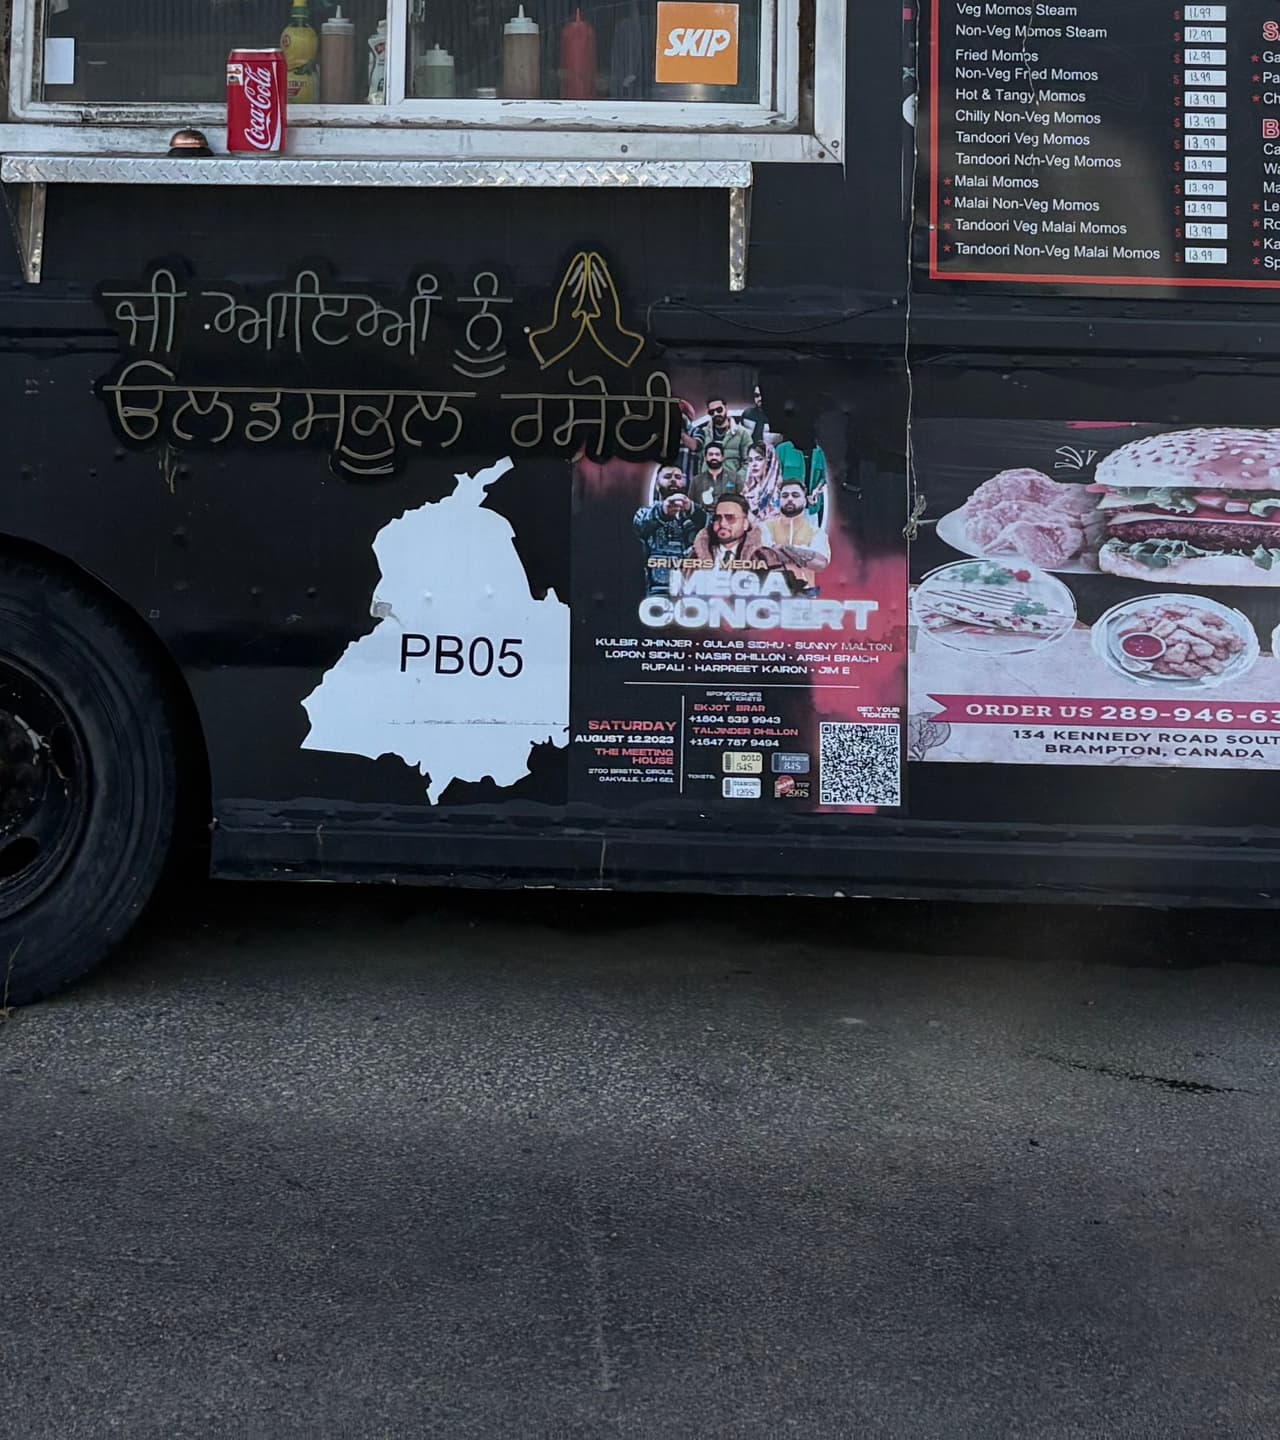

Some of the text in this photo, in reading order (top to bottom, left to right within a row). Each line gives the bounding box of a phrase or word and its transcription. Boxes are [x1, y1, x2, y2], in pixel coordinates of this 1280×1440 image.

[664, 28, 731, 58] SKIP
[955, 88, 1086, 104] Hot & Tangy Momos
[955, 242, 1160, 259] Tandoori Non-Veg Malai Momos
[648, 559, 768, 570] 5RIVERS MEDIA
[670, 570, 793, 597] MEGA
[639, 597, 879, 630] CONCERT
[595, 638, 638, 646] KULBIR
[703, 640, 744, 648] GULAB
[748, 641, 784, 649] SIDHU
[795, 642, 837, 650] SUNNY
[401, 634, 523, 678] PB05
[605, 650, 645, 659] LOPON
[649, 651, 685, 659] SIDHU
[696, 652, 731, 660] NASIR
[735, 653, 786, 661] DHILLON
[797, 654, 830, 662] ARSH
[642, 663, 684, 671] RUPALI
[695, 664, 758, 673] HARPREET
[762, 665, 807, 673] KAIRON
[818, 666, 839, 674] JIM
[966, 703, 1052, 718] ORDER
[1060, 705, 1092, 719] US
[588, 720, 676, 731] SATURDAY
[575, 735, 622, 743] AUGUST
[1013, 729, 1045, 740] 134
[1053, 730, 1151, 743] KENNEDY
[1159, 733, 1218, 744] ROAD
[594, 748, 674, 757] THE MEETING
[1045, 743, 1264, 759] BRAMPTON, CANADA
[632, 757, 674, 765] HOUSE
